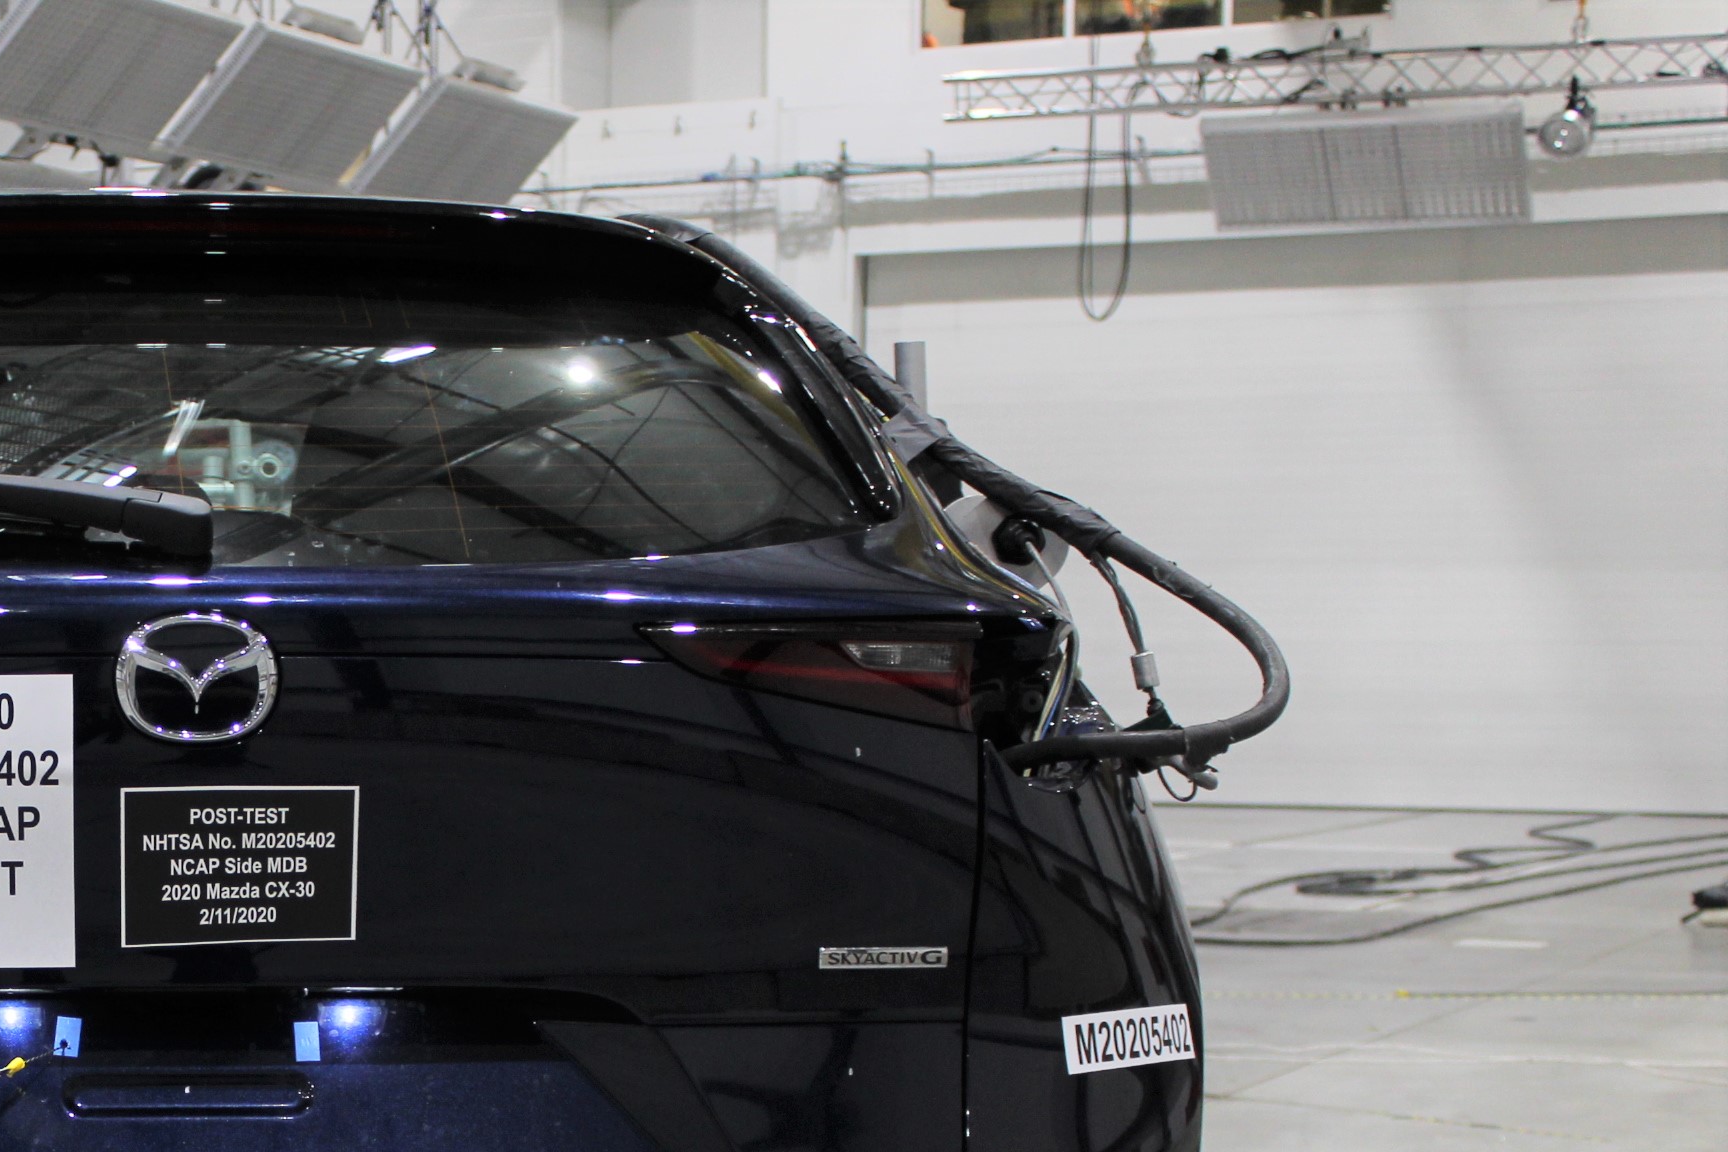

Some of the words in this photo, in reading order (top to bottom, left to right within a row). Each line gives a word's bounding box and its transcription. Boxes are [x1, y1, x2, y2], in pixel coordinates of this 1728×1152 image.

[189, 807, 290, 825] POST-TEST
[142, 833, 205, 852] NHTSA
[208, 832, 237, 850] No.
[241, 831, 336, 850] M20205402
[170, 857, 220, 876] NCAP
[224, 857, 263, 875] Side
[267, 856, 308, 874] MDB
[161, 883, 201, 902] 2020
[206, 881, 261, 900] Mazda
[265, 880, 316, 899] CX-30
[199, 906, 277, 926] 2/11/2020
[1074, 1012, 1192, 1067] M20205402
